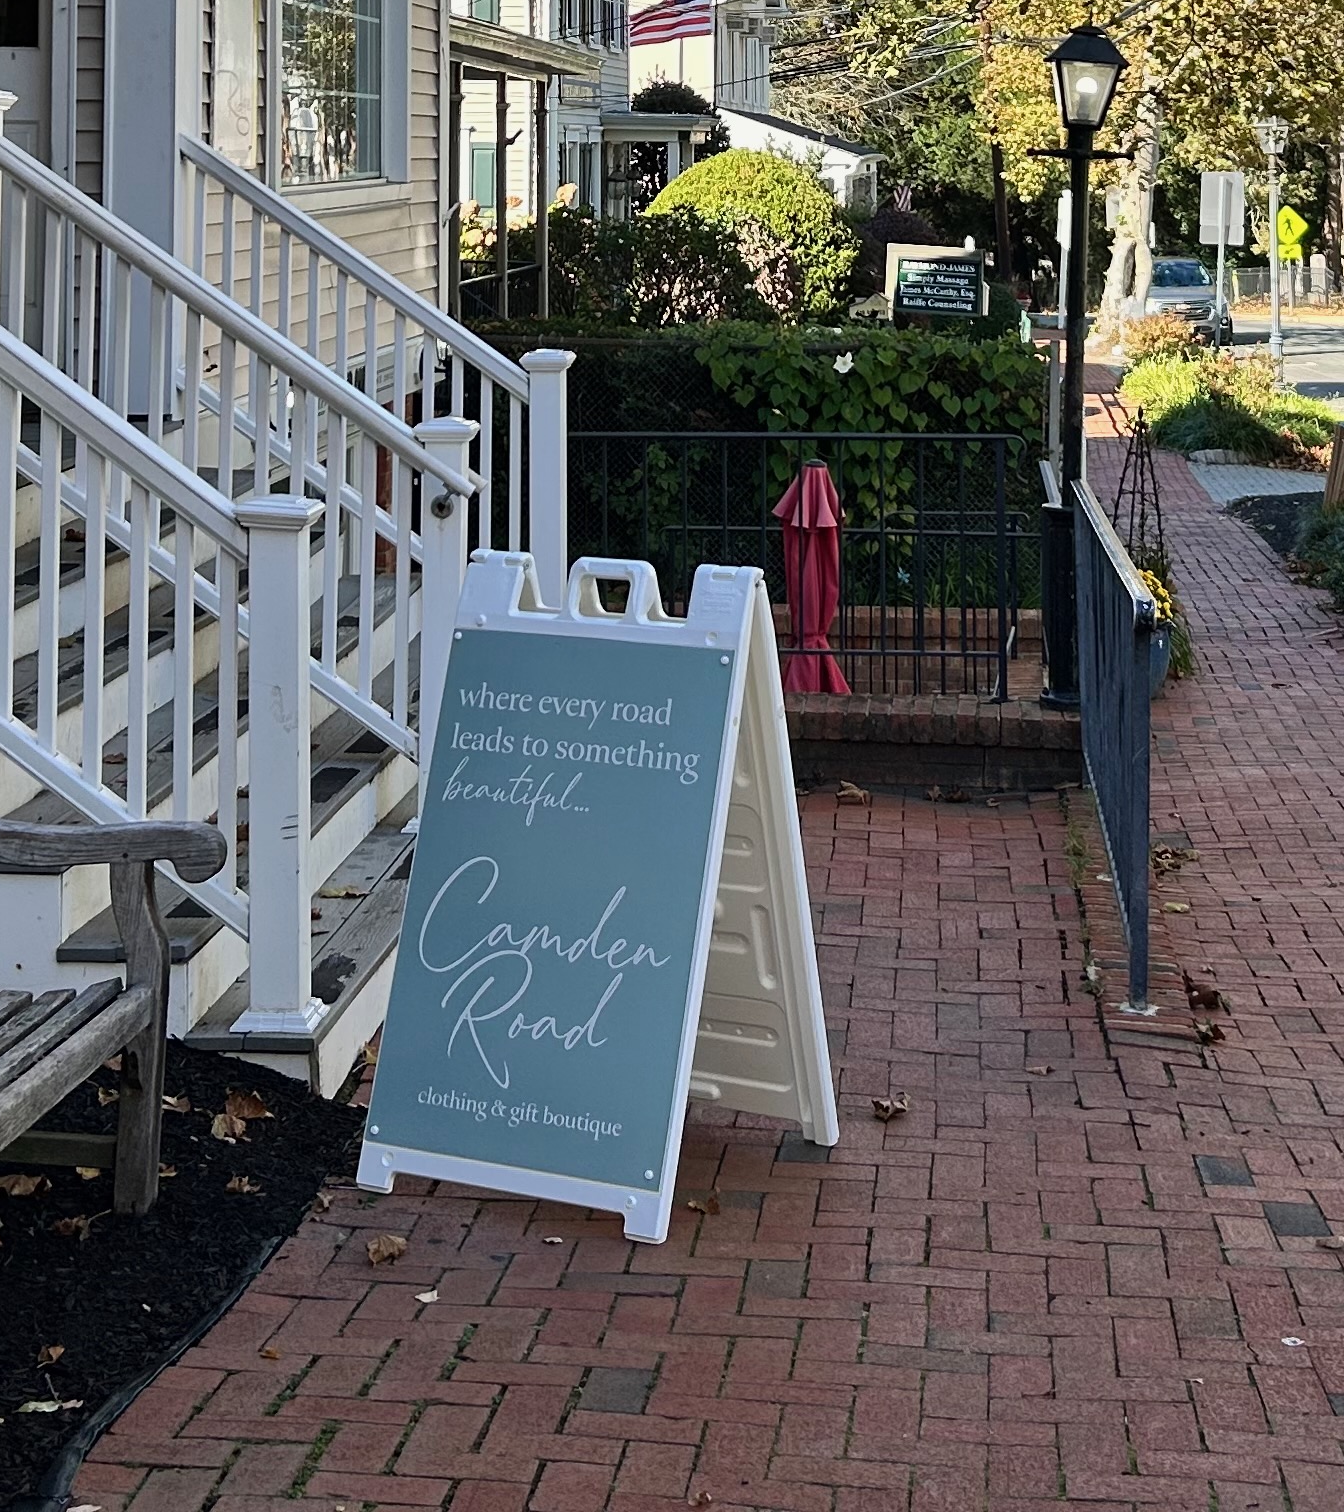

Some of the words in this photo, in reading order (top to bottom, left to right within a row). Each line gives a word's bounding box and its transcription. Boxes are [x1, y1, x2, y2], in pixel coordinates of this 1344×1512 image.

[927, 298, 973, 311] Counseling
[935, 274, 969, 286] Massage
[459, 681, 533, 713] where
[538, 695, 606, 731] every
[611, 698, 673, 726] road
[450, 722, 515, 754] leads
[522, 734, 549, 757] to
[554, 739, 701, 785] something
[419, 856, 671, 972] Camden
[441, 950, 623, 1088] Road
[417, 1086, 488, 1122] clothing
[491, 1099, 507, 1118] &
[508, 1101, 539, 1128] gift
[543, 1105, 623, 1141] boutique
